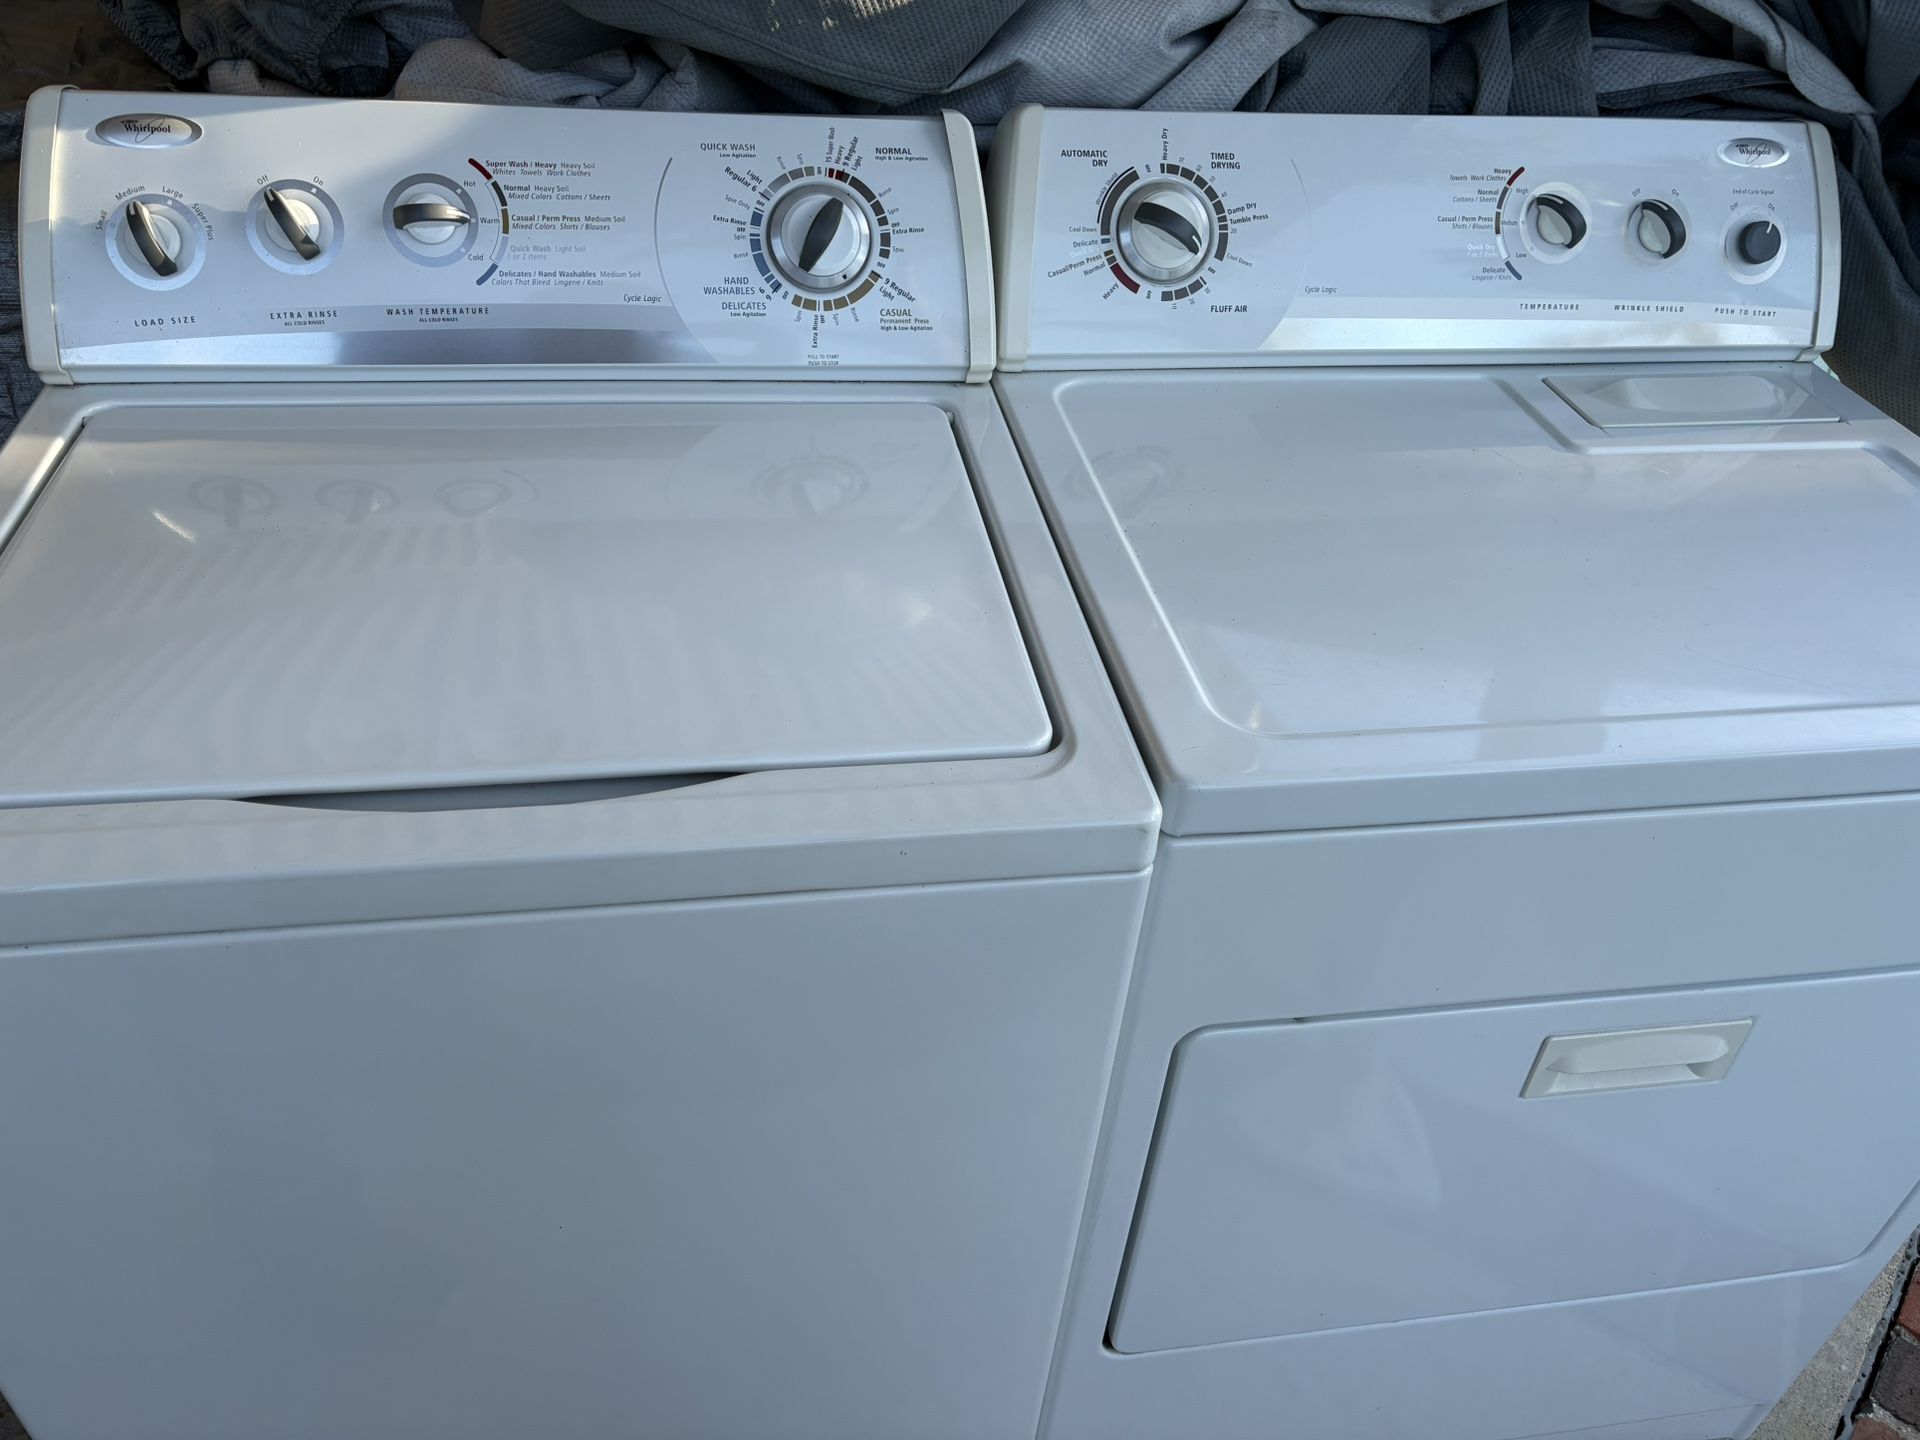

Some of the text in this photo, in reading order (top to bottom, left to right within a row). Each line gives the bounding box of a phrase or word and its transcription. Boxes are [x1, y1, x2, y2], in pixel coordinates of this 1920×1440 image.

[123, 123, 171, 134] Whirlpool
[700, 142, 756, 151] QUICK WASH
[846, 136, 859, 160] Regular
[834, 145, 846, 164] Heavy
[1061, 149, 1108, 158] AUTOMATIC
[1210, 152, 1235, 160] TIMED
[1738, 147, 1772, 157] Whirlpool
[486, 160, 506, 168] Super
[535, 161, 557, 170] Heavy
[560, 162, 582, 170] Heavy
[851, 156, 863, 171] Light
[1092, 159, 1108, 167] DRY
[1211, 162, 1240, 170] DRYING
[256, 174, 269, 185] Off
[313, 176, 324, 186] On
[724, 166, 751, 188] Regular
[746, 169, 763, 185] Light
[464, 180, 476, 188] Hot
[534, 185, 555, 193] Heavy
[115, 184, 146, 201] Medium
[162, 186, 184, 200] Large
[1632, 188, 1641, 197] Off
[1671, 188, 1680, 198] On
[1227, 202, 1257, 215] Damp Dry
[1730, 202, 1739, 211] Off
[95, 209, 108, 232] Small
[192, 202, 214, 240] Super Plus
[480, 216, 500, 224] Warm
[713, 214, 746, 226] Extra Rinse
[1230, 216, 1251, 225] Tumble
[1072, 239, 1098, 248] Delicate
[1048, 254, 1102, 278] Casual/Perm Press
[1083, 262, 1106, 277] Normal
[554, 279, 580, 287] Lingerie
[724, 276, 749, 285] HAND
[703, 286, 756, 295] WASHABLES
[879, 285, 895, 301] Light
[889, 281, 916, 303] Regular
[1102, 282, 1119, 300] Heavy
[1305, 285, 1337, 294] Cycle Logic
[624, 294, 662, 303] Cycle Logic
[419, 307, 490, 315] TEMPERATURE
[722, 302, 767, 310] DELICATES
[1211, 305, 1232, 313] FLUFF
[270, 310, 338, 320] EXTRA RINSE
[880, 308, 912, 317] CASUAL
[134, 316, 196, 327] LOAD SIZE
